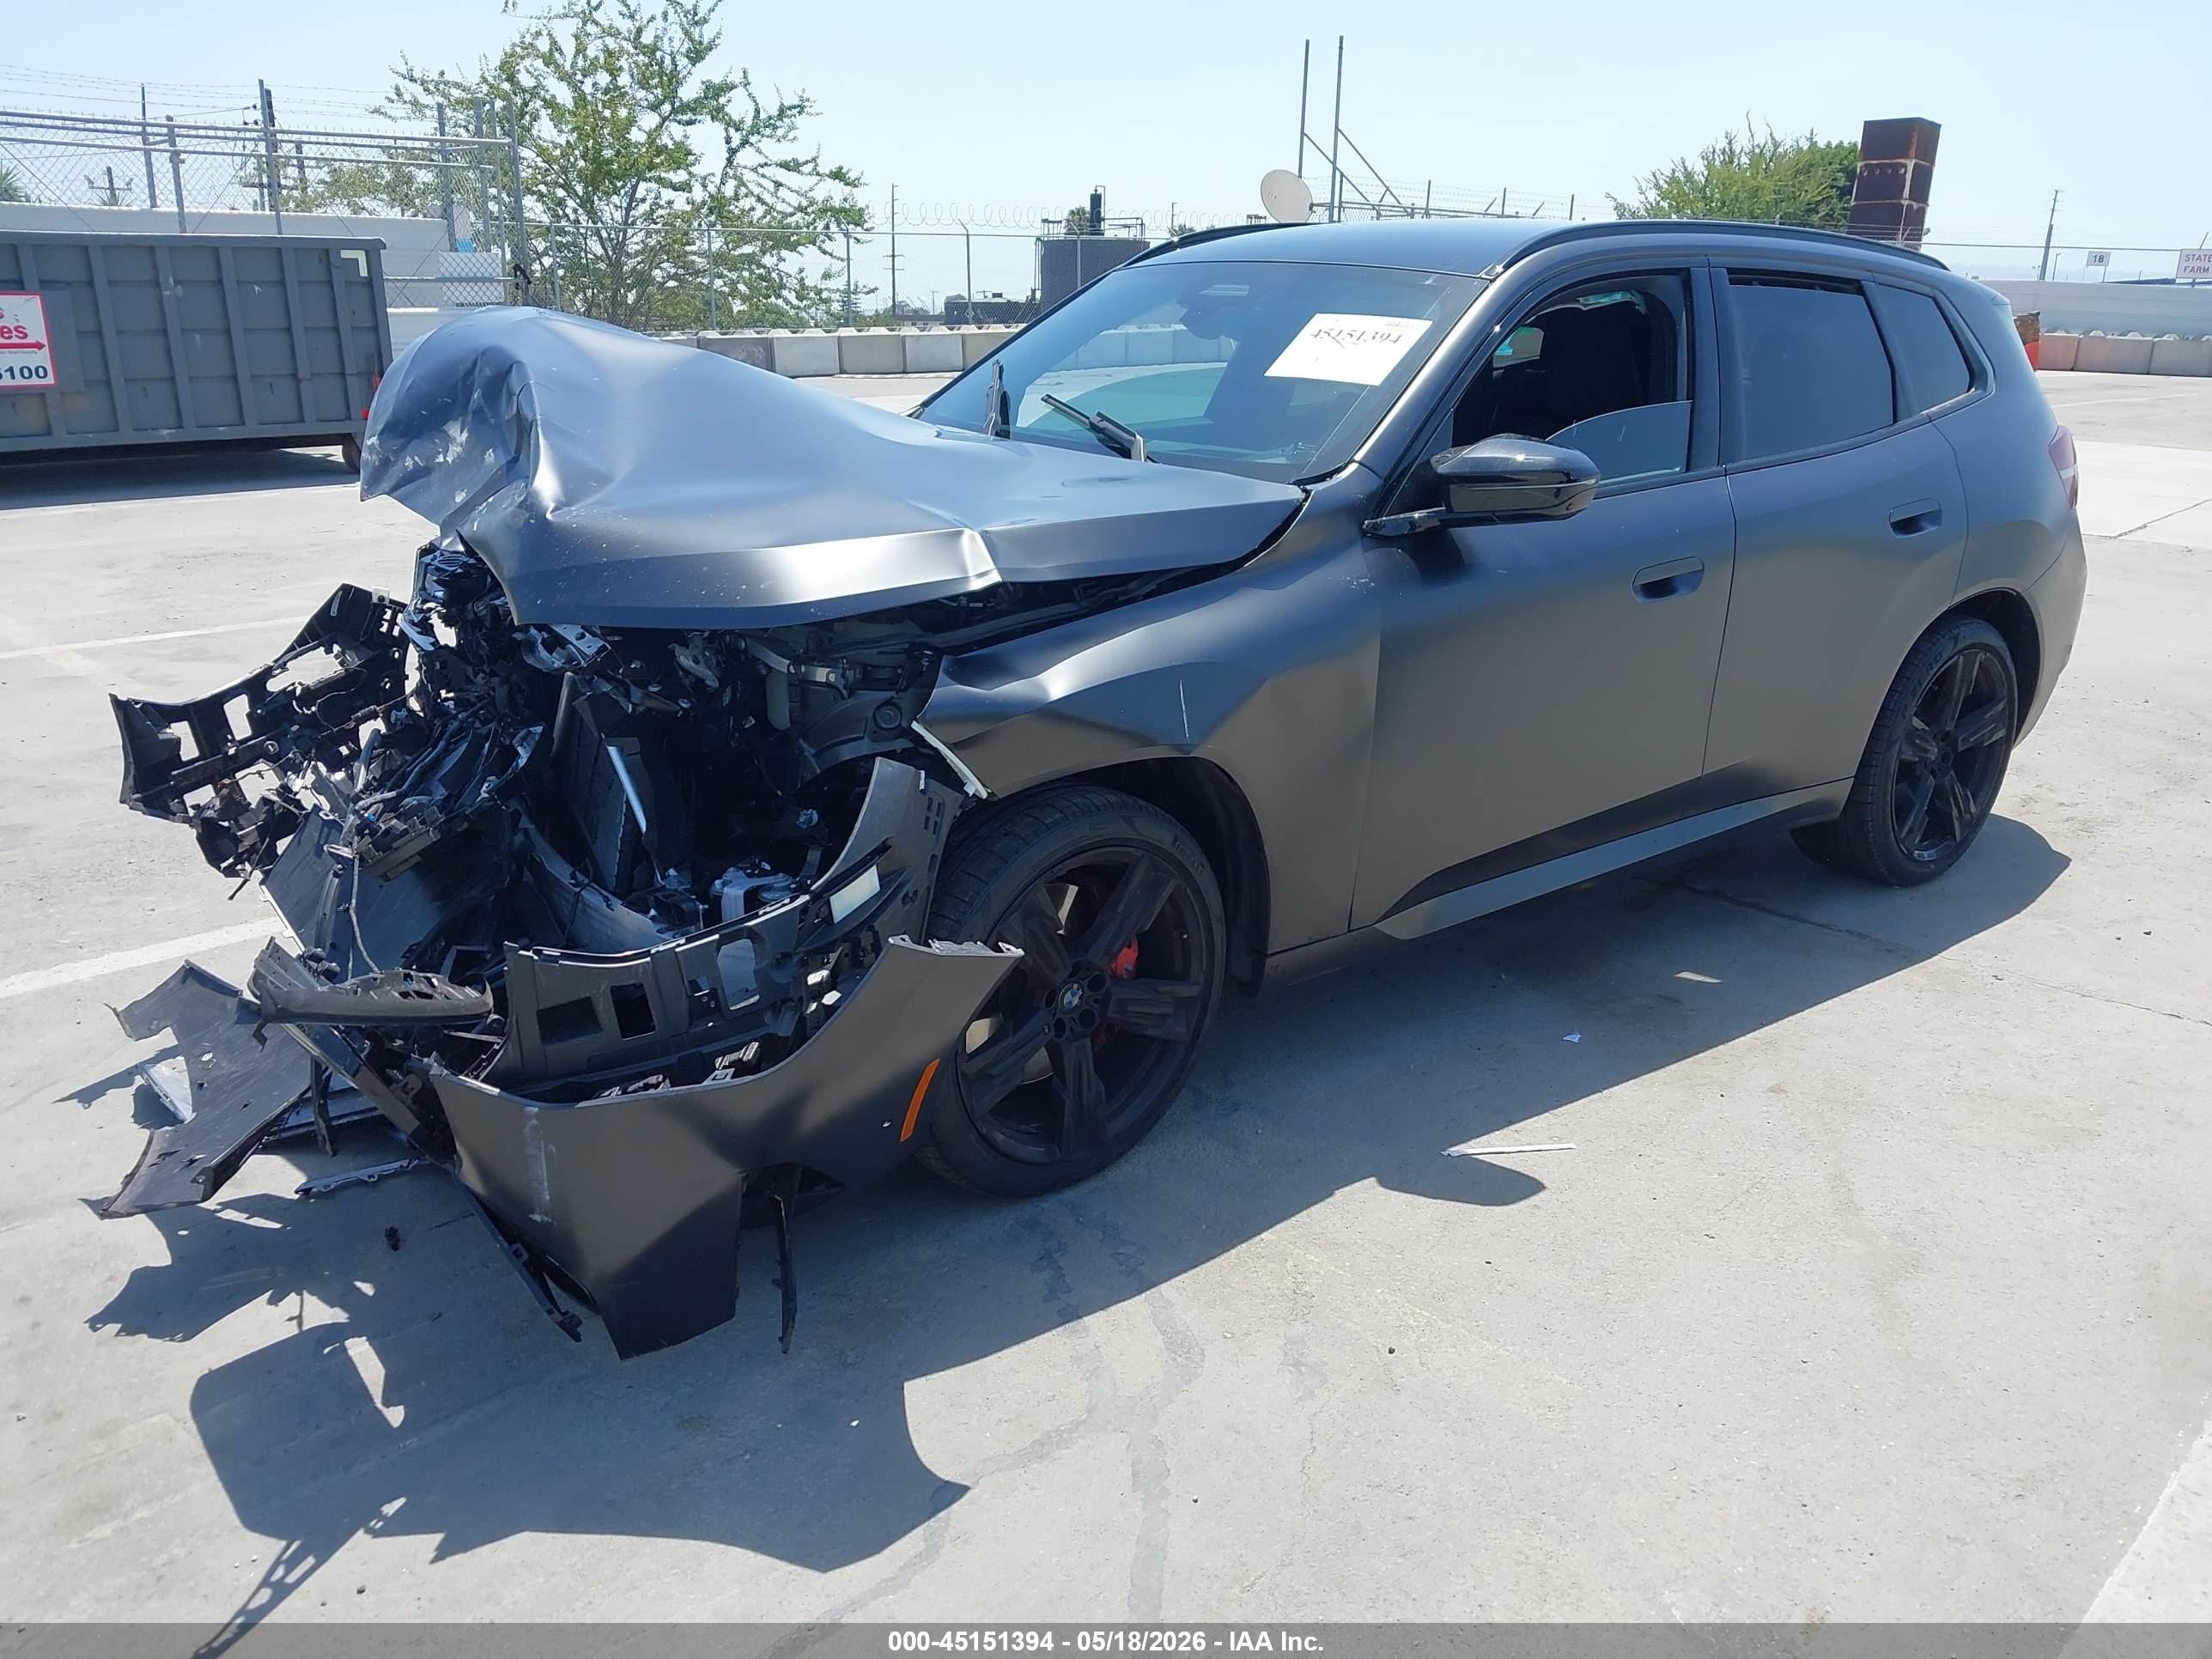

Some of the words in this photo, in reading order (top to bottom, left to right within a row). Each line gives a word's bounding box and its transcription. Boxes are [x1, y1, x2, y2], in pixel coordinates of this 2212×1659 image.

[2093, 254, 2105, 263] 18
[2183, 265, 2210, 275] FARM
[0, 365, 49, 380] 100
